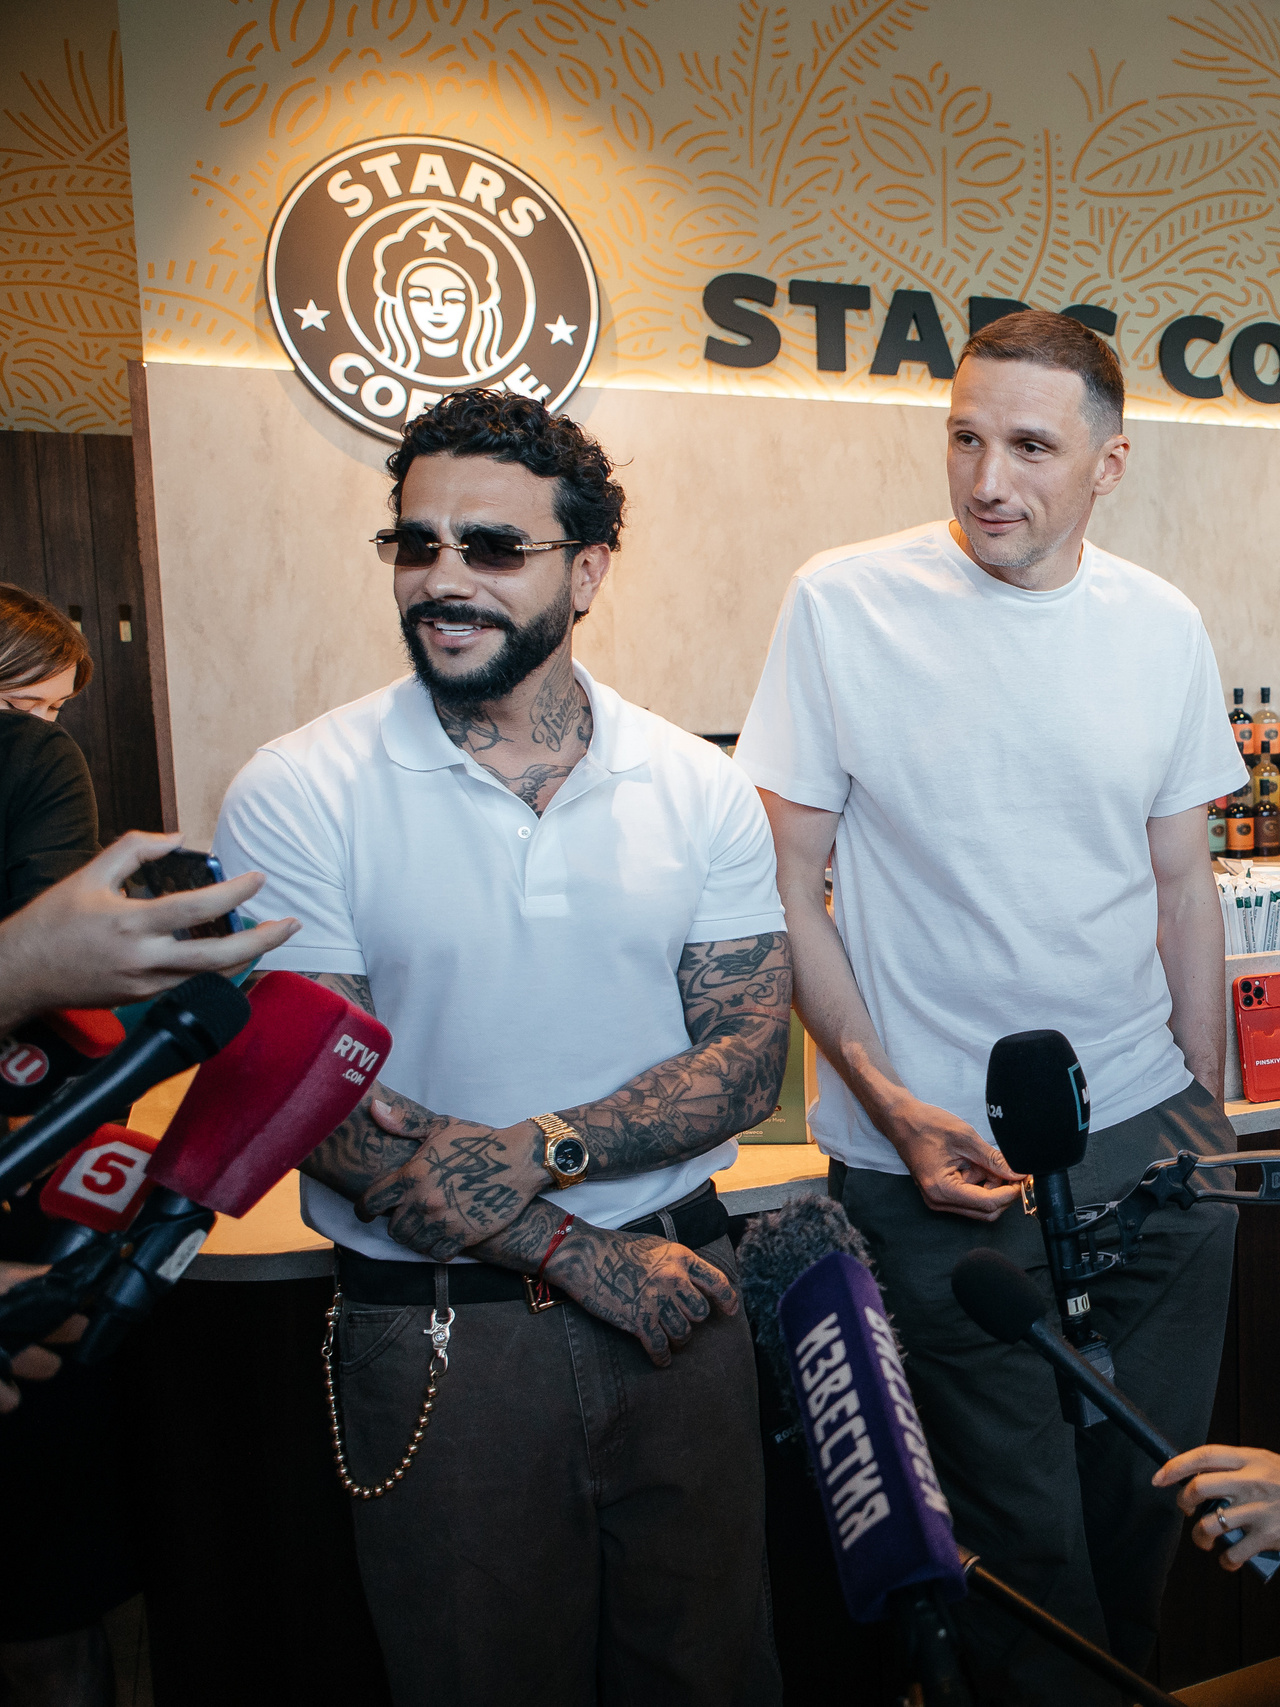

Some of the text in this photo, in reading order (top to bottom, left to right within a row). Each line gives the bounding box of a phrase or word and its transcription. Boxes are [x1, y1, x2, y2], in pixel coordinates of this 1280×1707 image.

[326, 153, 547, 238] STARS
[702, 272, 1117, 380] STA
[329, 351, 551, 423] COFE
[342, 1068, 366, 1086] .COM
[82, 1151, 136, 1195] 5
[1073, 1296, 1089, 1312] 10
[796, 1312, 891, 1551] ИЗВЕСТИЯ
